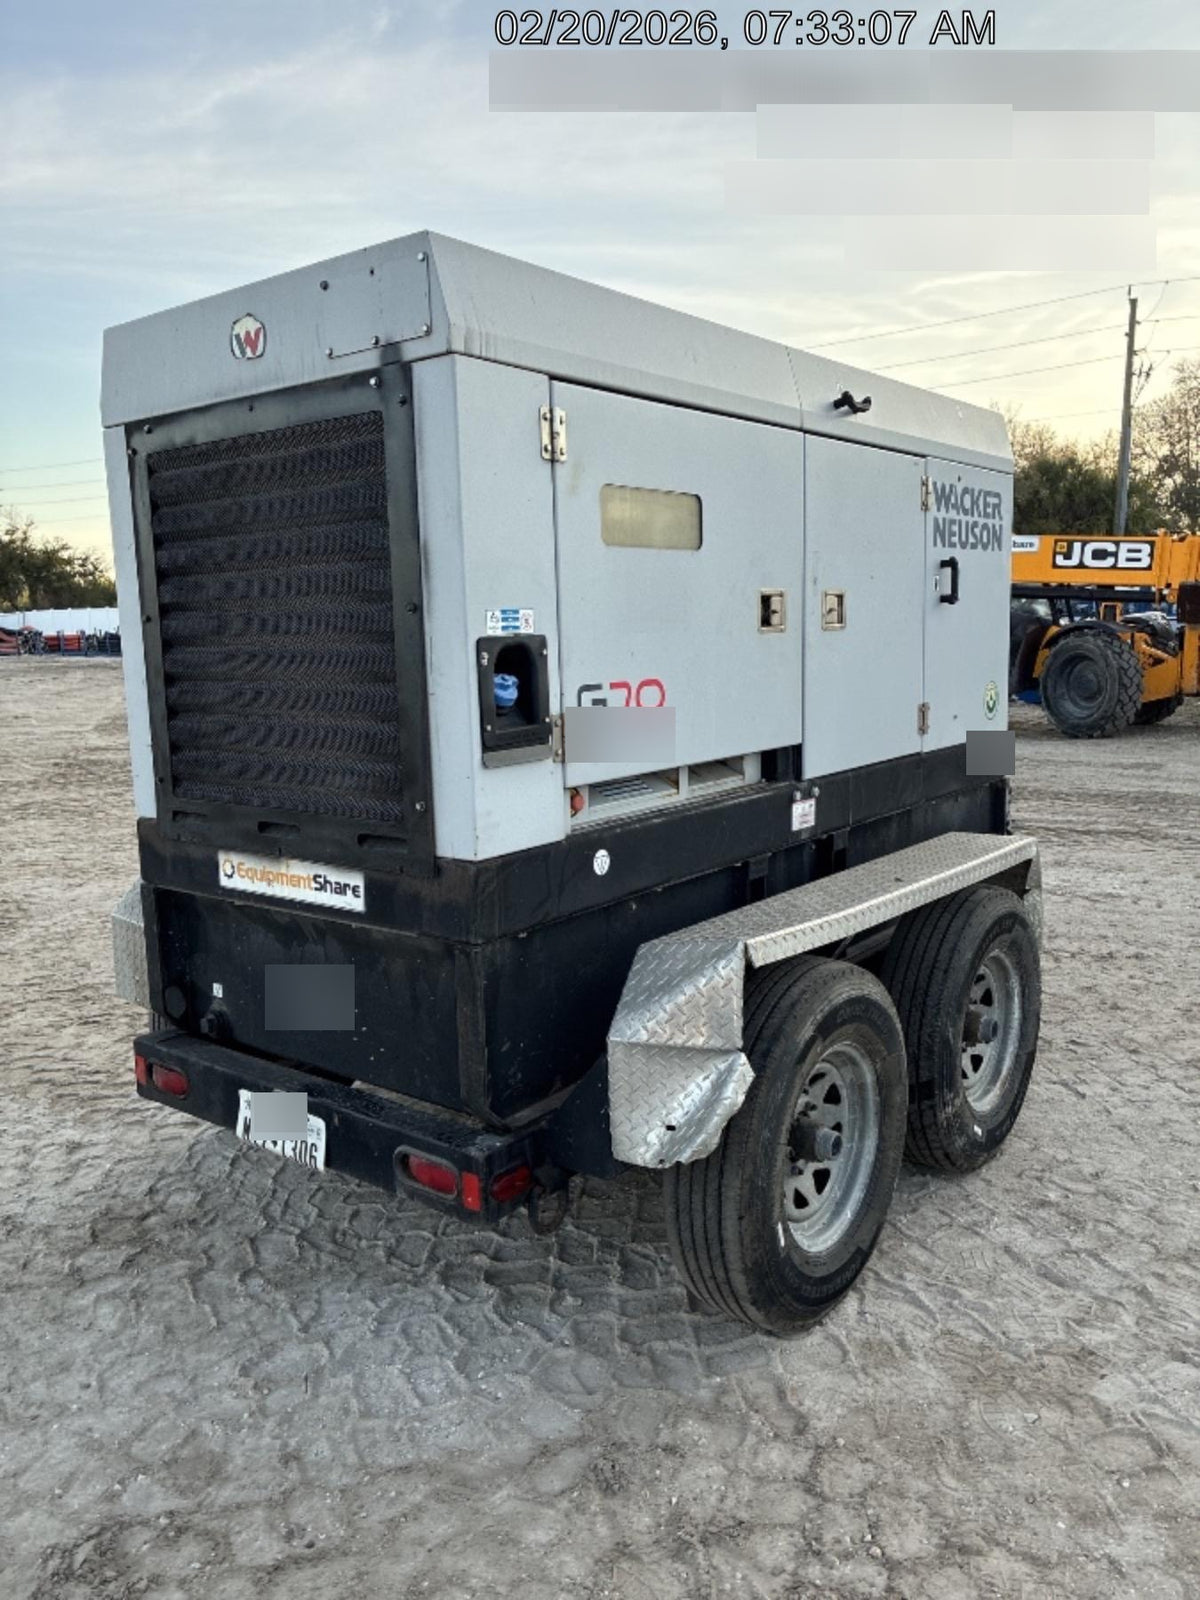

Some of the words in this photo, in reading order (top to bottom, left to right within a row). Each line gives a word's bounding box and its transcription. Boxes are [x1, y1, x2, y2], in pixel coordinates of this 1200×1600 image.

[932, 480, 1003, 520] WACKER
[933, 517, 1003, 552] NEUSON
[1055, 541, 1151, 568] JCB
[236, 861, 362, 899] EquipmentShare
